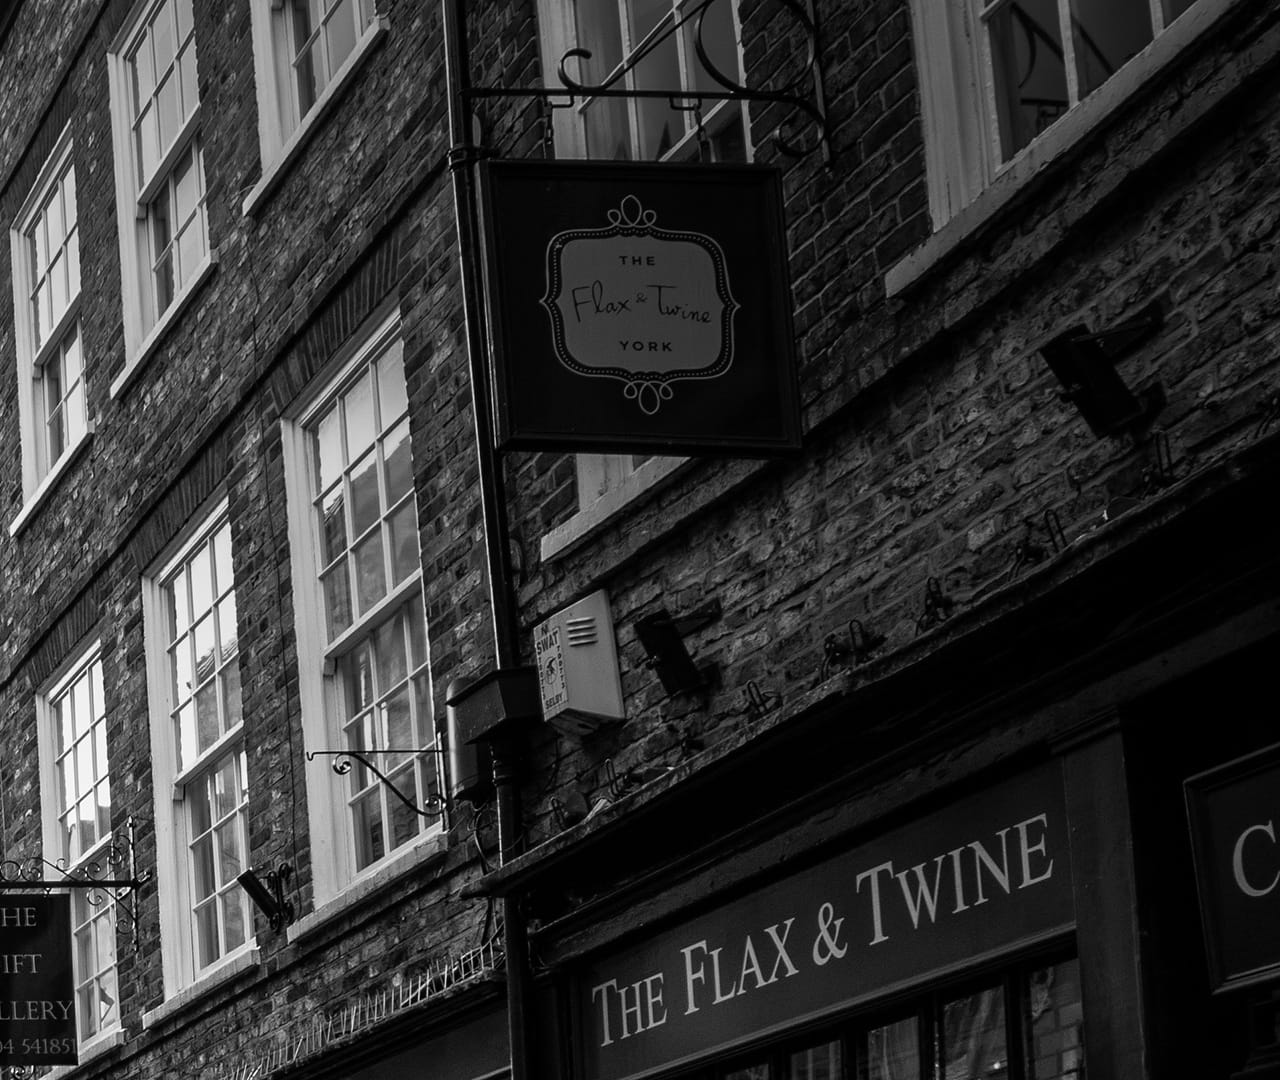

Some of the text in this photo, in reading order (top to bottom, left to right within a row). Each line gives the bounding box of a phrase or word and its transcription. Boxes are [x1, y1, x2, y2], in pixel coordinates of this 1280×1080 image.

[619, 256, 656, 266] THE
[571, 279, 711, 324] Flax & Twine
[620, 341, 673, 352] YORK
[536, 630, 558, 655] SWAT
[545, 691, 563, 709] SELBY
[591, 812, 1055, 1050] THE FLAX & TWINE
[21, 1038, 77, 1055] 541851
